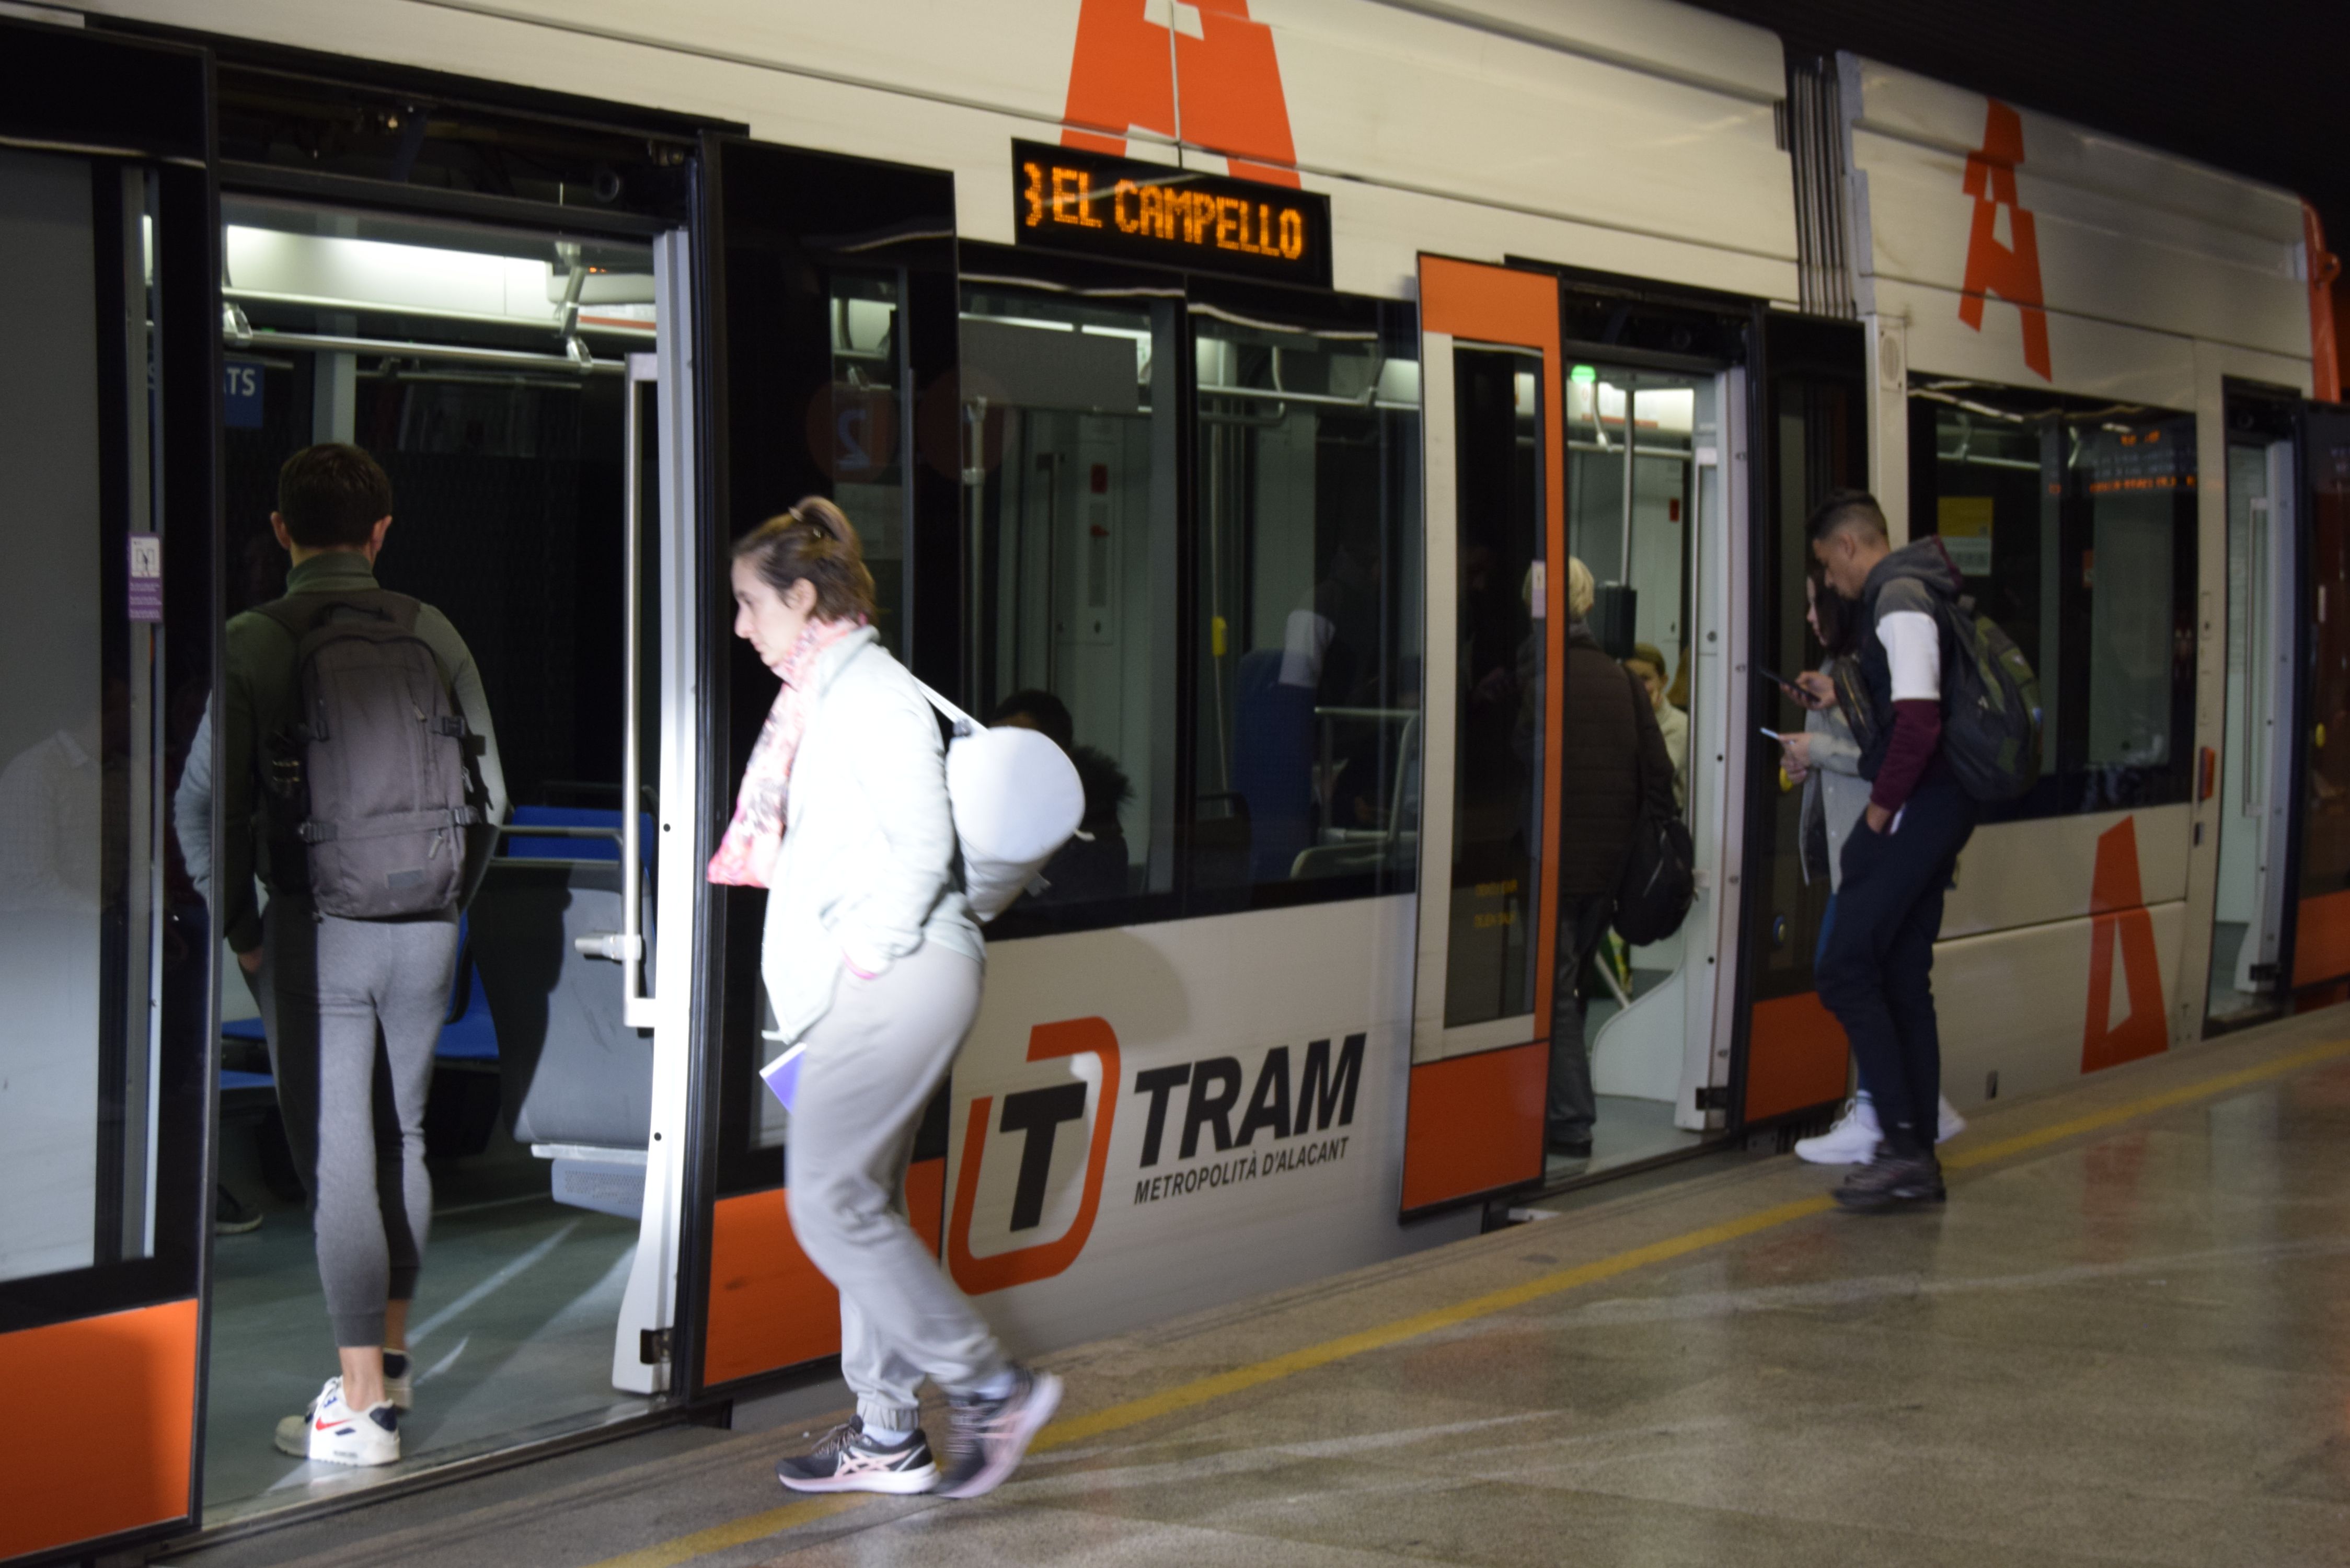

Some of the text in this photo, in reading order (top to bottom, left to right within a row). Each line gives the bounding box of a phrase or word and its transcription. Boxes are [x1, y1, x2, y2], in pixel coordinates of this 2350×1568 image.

[1051, 165, 1103, 229] EL
[1114, 178, 1303, 260] CAMPELLO
[1135, 1033, 1366, 1168] TRAM
[1134, 1136, 1350, 1204] METROPOLITÀ D'ALACANT
